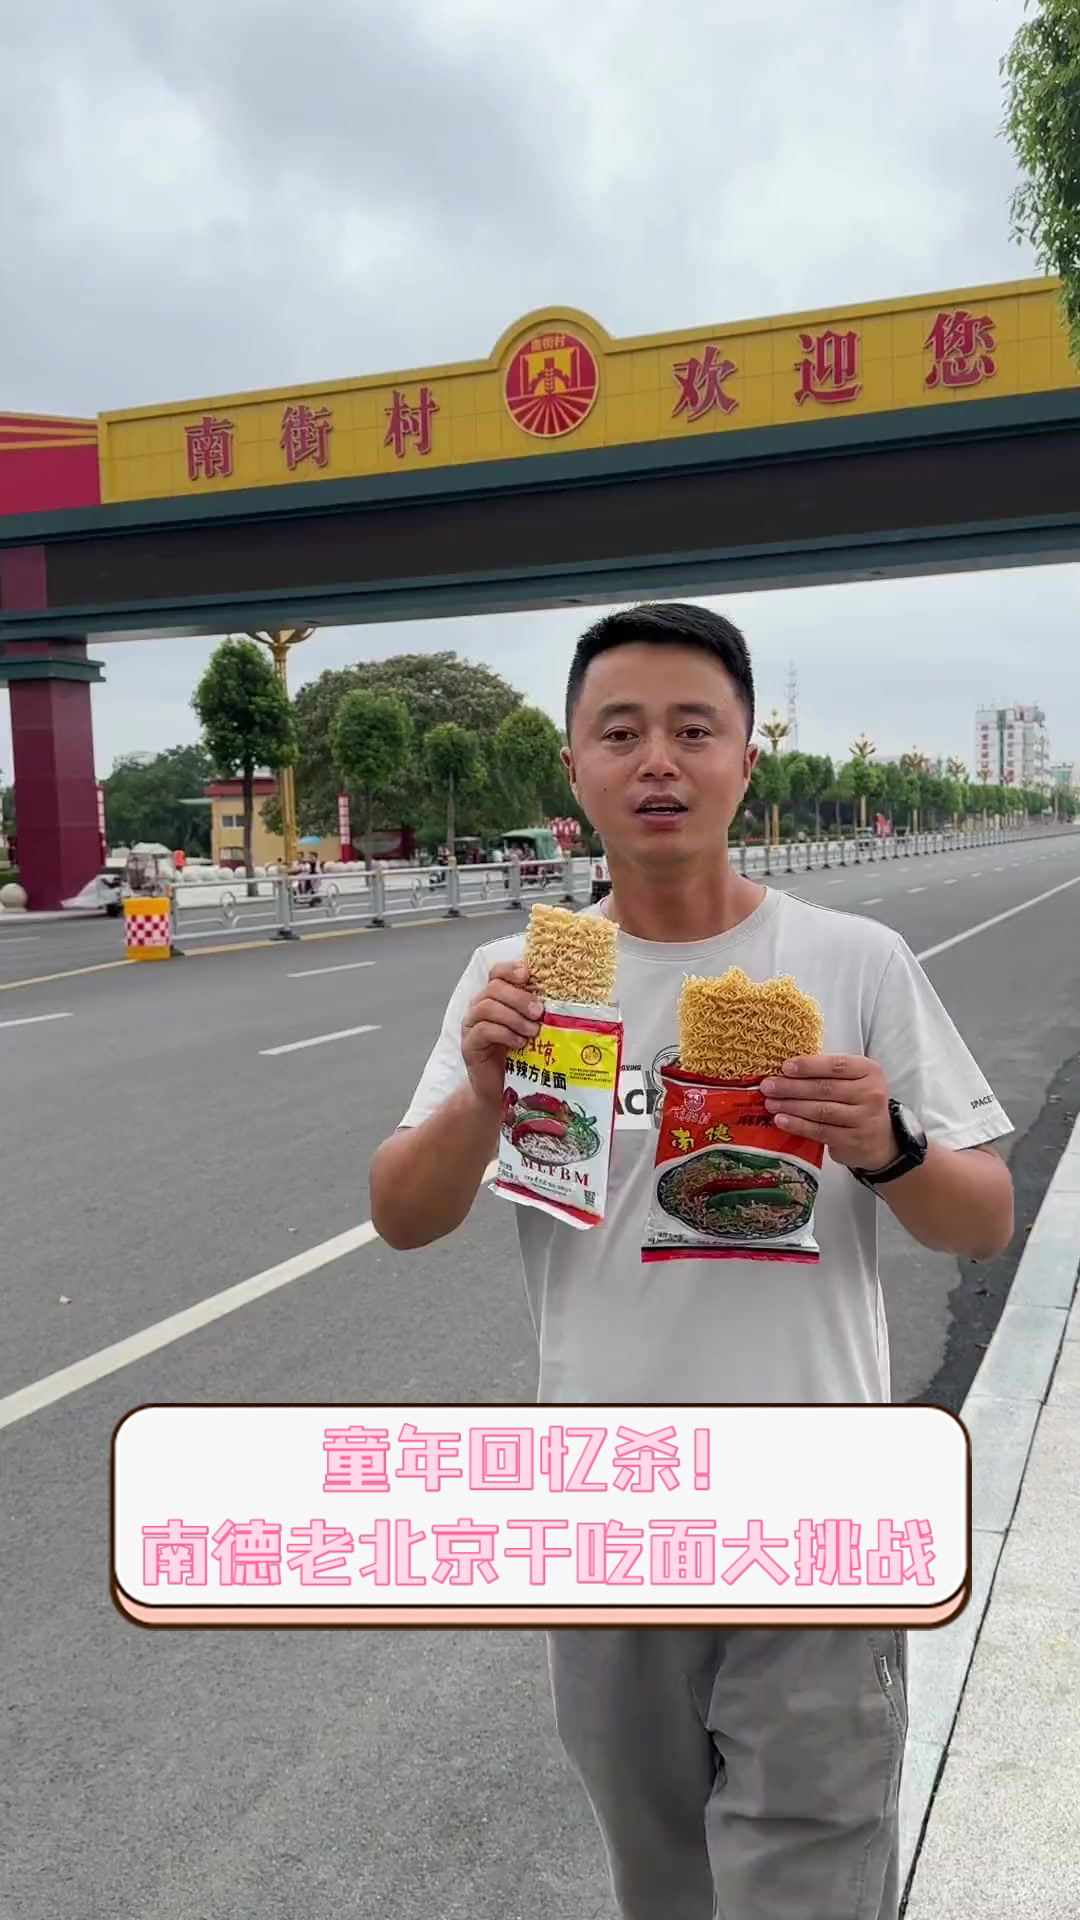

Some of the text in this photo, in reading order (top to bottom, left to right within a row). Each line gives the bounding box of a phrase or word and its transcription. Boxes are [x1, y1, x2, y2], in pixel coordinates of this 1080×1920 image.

[184, 310, 997, 481] 南街村 欢迎您
[504, 1057, 567, 1091] 麻辣方便面
